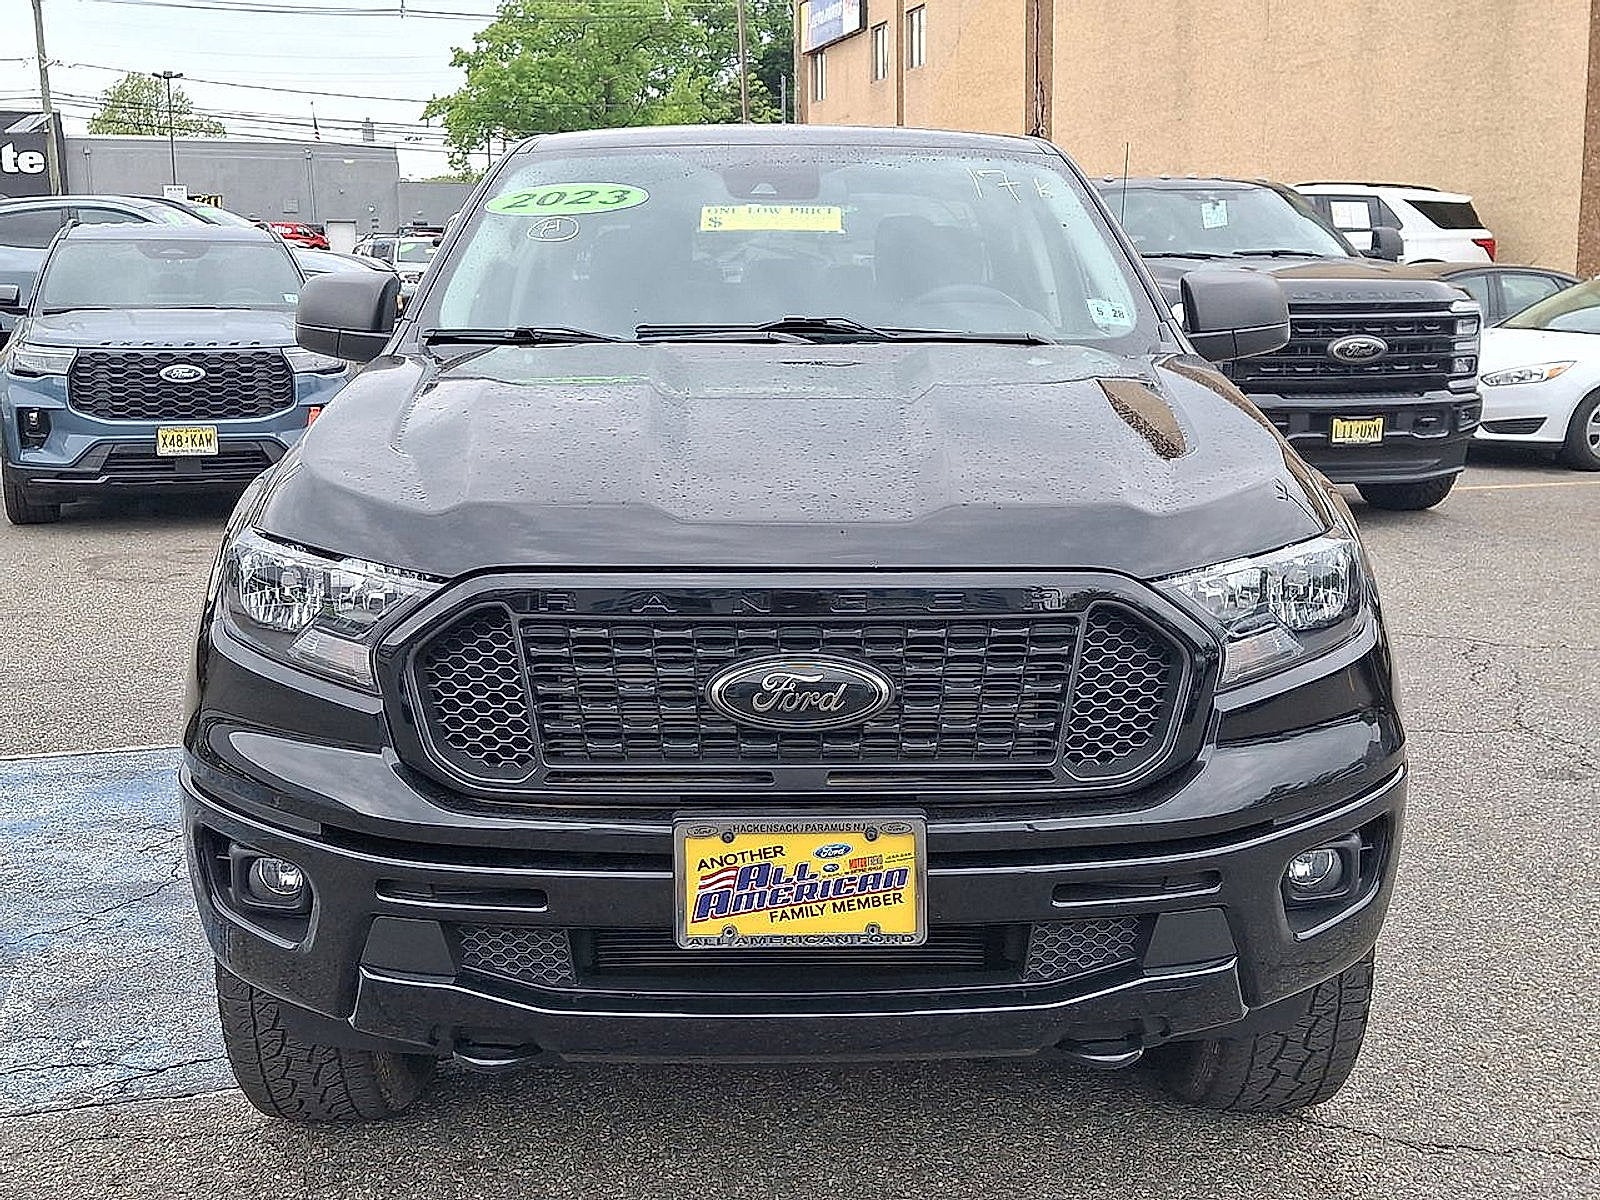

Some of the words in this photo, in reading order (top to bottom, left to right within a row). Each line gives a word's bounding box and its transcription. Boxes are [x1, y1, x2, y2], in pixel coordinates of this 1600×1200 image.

[502, 189, 631, 210] 2023
[707, 206, 736, 215] ONE
[748, 206, 781, 215] LOW
[790, 206, 833, 215] PRICE
[708, 215, 723, 229] $
[537, 587, 1066, 613] RANGER
[752, 671, 848, 714] Ford
[697, 845, 786, 872] ANOTHER
[736, 862, 819, 892] ALL
[693, 866, 911, 921] AMERICAN
[768, 903, 828, 923] FAMILY
[832, 892, 905, 914] MEMBER
[688, 936, 727, 946] ALL
[734, 936, 849, 946] AMERICAN
[857, 935, 914, 944] FORD
